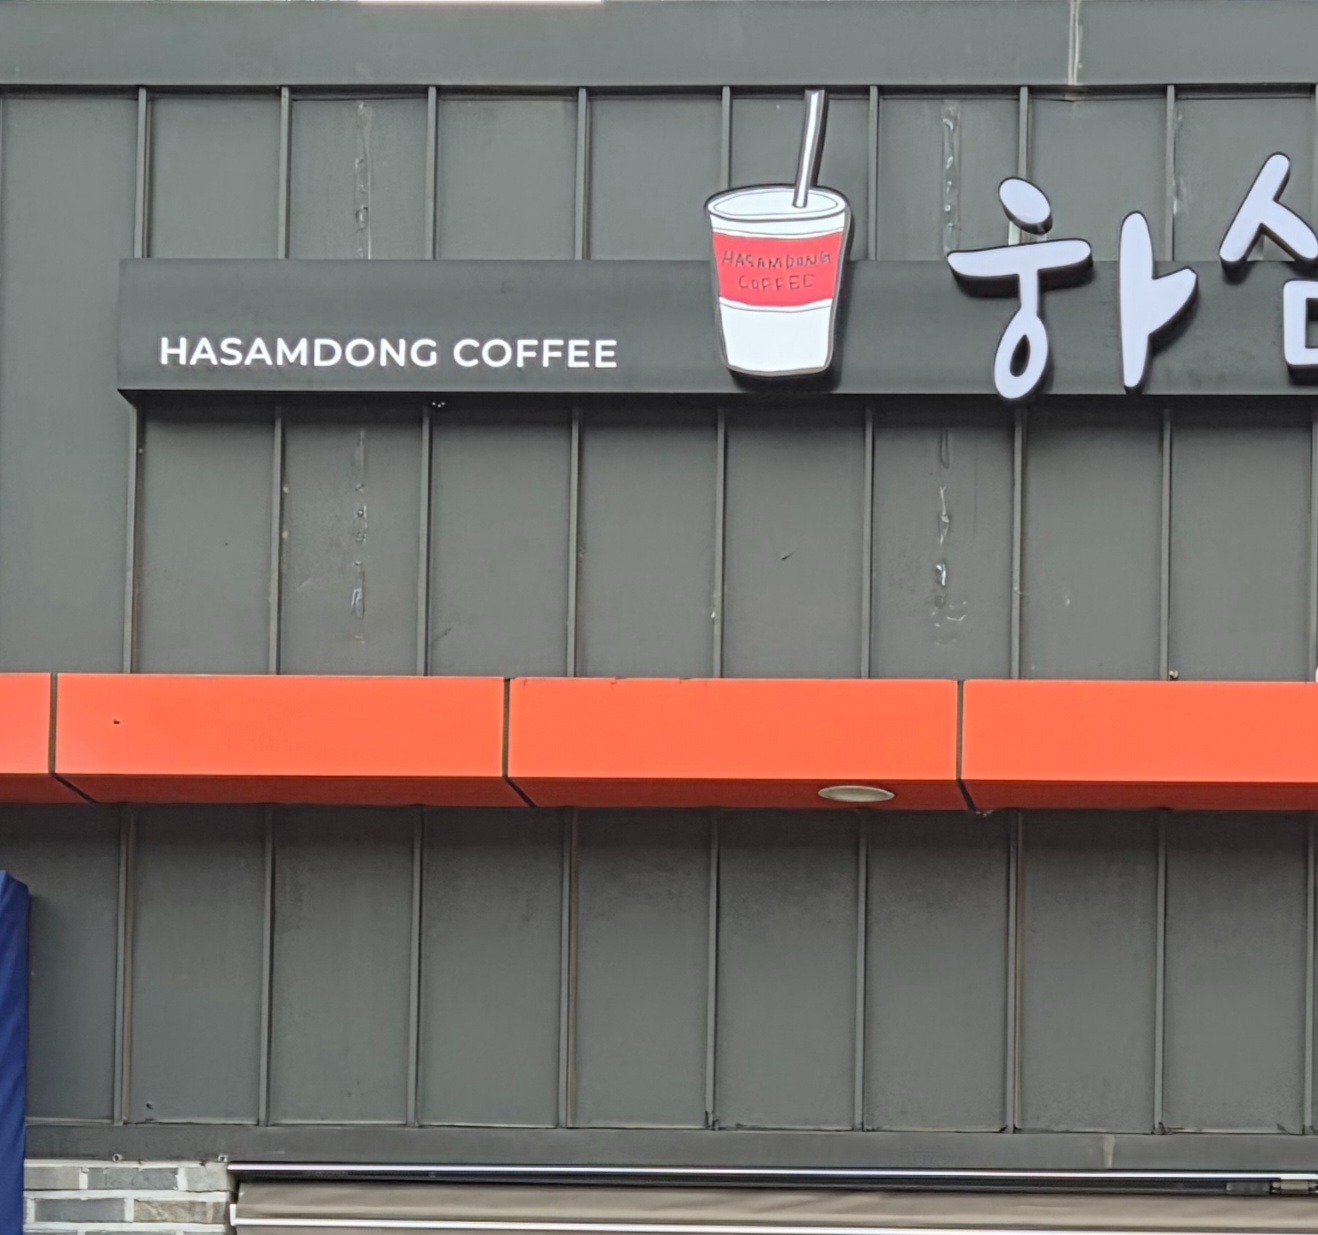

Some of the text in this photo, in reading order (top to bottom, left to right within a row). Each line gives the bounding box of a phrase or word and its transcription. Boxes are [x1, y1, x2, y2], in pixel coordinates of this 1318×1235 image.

[722, 251, 832, 270] HASAMDONG
[738, 274, 815, 292] COFFEE
[159, 336, 618, 369] HASAMDONG COFFEE
